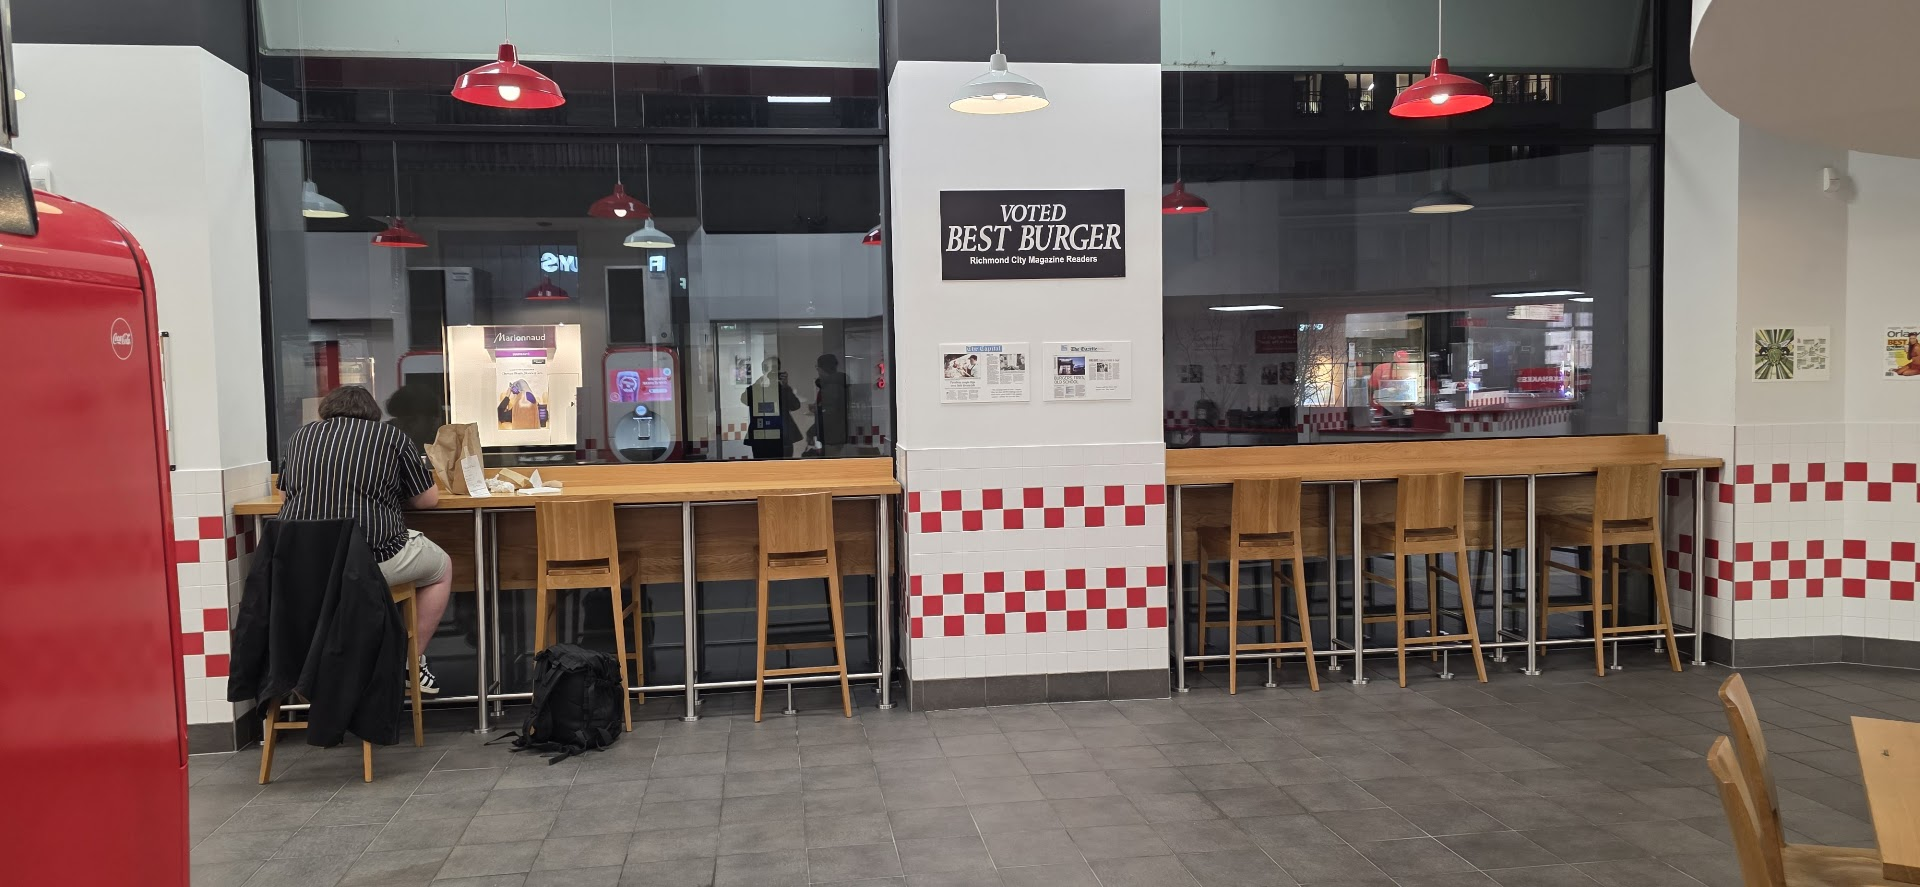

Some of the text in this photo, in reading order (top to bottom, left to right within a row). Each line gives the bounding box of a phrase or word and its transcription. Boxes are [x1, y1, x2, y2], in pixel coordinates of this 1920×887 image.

[1000, 204, 1067, 222] VOTED
[946, 223, 1122, 252] BEST BURGER
[970, 254, 1098, 266] Richmond City Magazine Readers
[113, 333, 130, 345] Coca-Cola
[494, 333, 546, 343] Marionnaud
